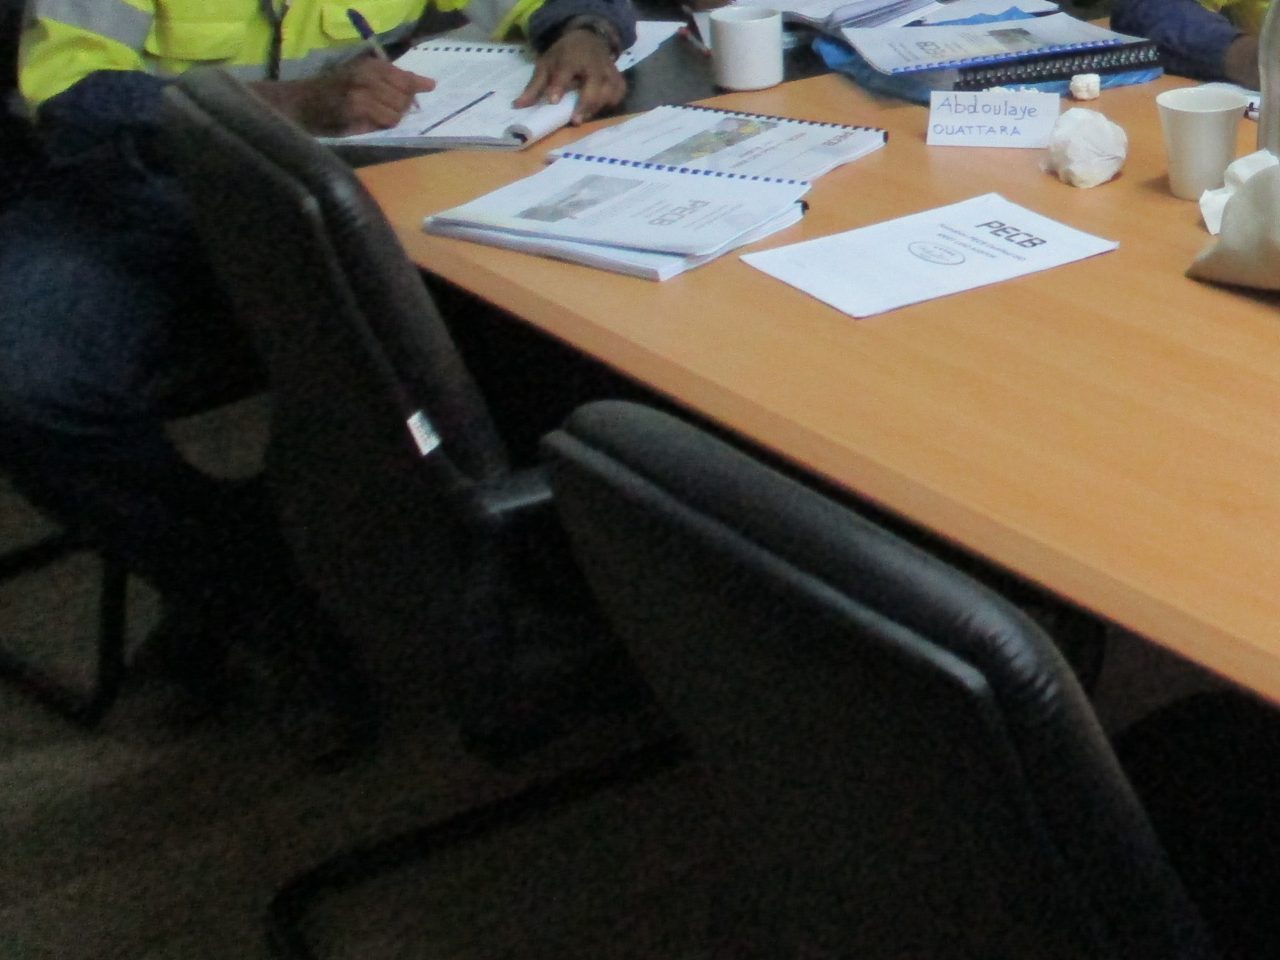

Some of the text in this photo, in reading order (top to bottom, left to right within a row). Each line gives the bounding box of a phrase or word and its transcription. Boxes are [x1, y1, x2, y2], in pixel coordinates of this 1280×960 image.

[937, 94, 1038, 121] Abdoulaye
[932, 123, 1022, 136] OUATTARA
[975, 220, 1048, 249] PECB
